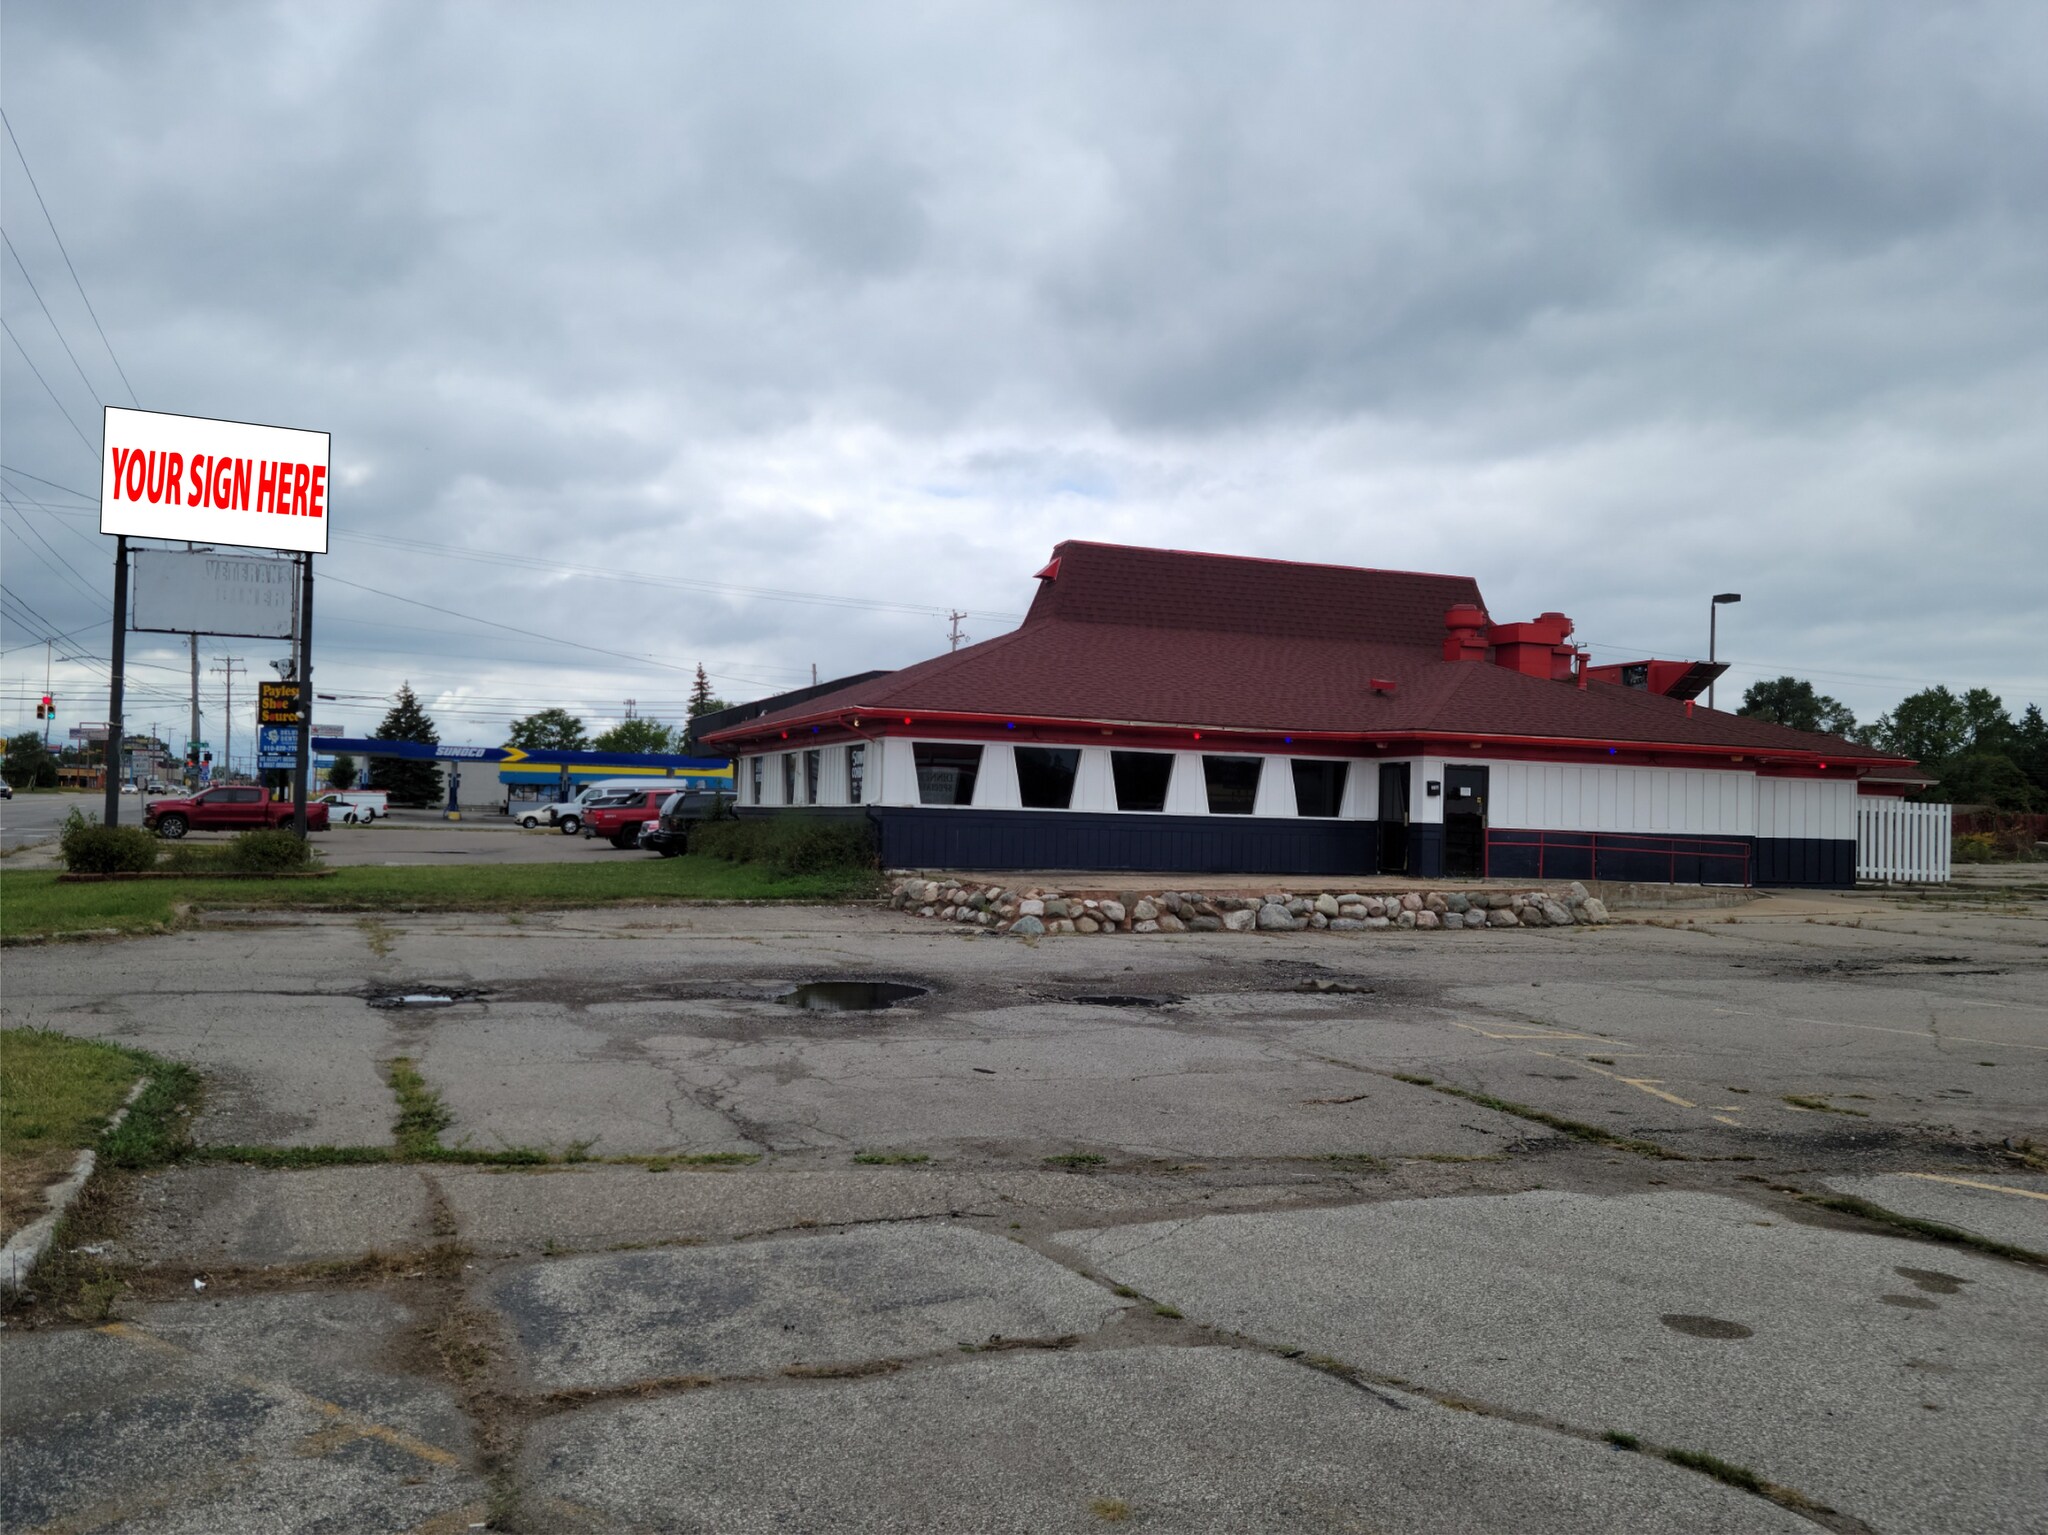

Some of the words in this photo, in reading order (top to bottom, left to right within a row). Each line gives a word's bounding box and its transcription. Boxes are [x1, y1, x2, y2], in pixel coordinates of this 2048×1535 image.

[112, 447, 184, 505] YOUR
[187, 454, 253, 511] SIGN
[256, 460, 327, 518] HERE
[206, 560, 291, 583] VETERANS
[262, 698, 289, 709] Shoe
[435, 746, 486, 758] SUNOCO
